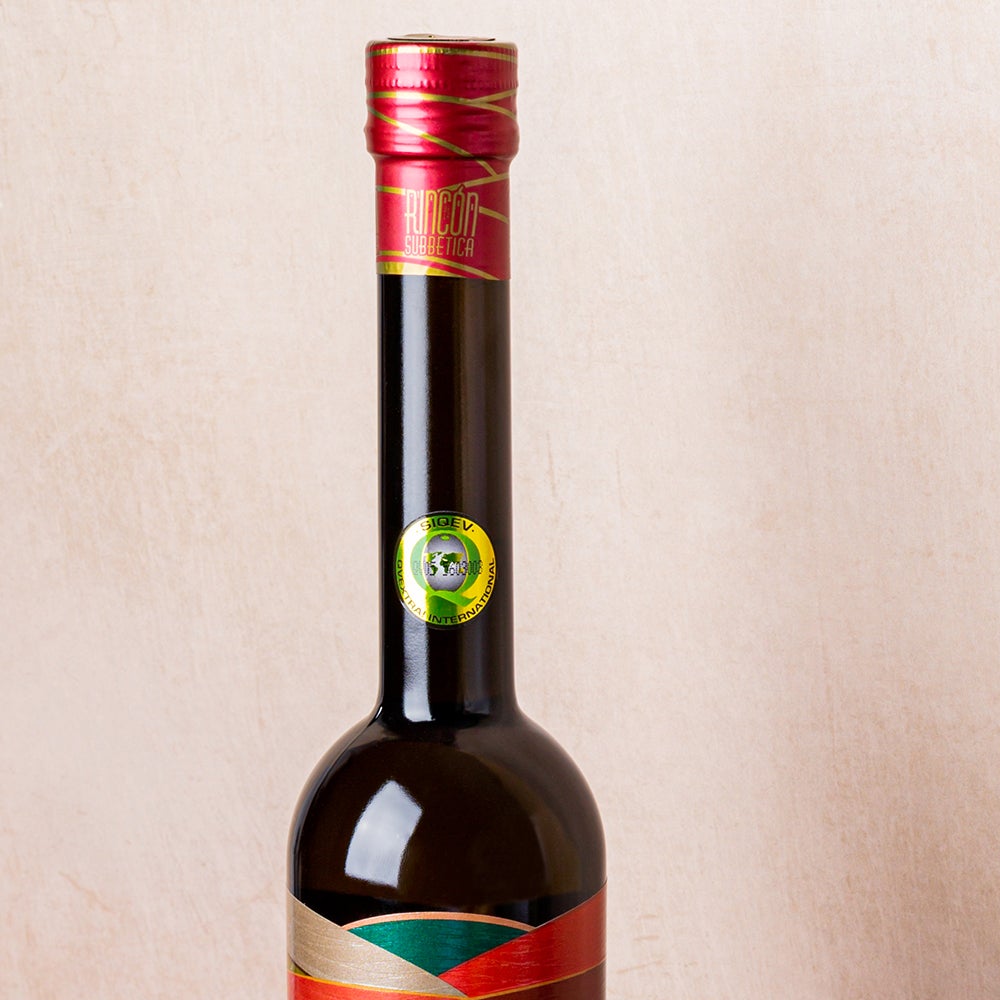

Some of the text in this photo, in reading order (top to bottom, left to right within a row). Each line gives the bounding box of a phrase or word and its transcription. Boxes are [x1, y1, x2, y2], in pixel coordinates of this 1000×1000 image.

[404, 185, 479, 236] RINCÓN
[420, 517, 473, 531] SIQEV
[428, 558, 496, 624] INTERNATIONAL
